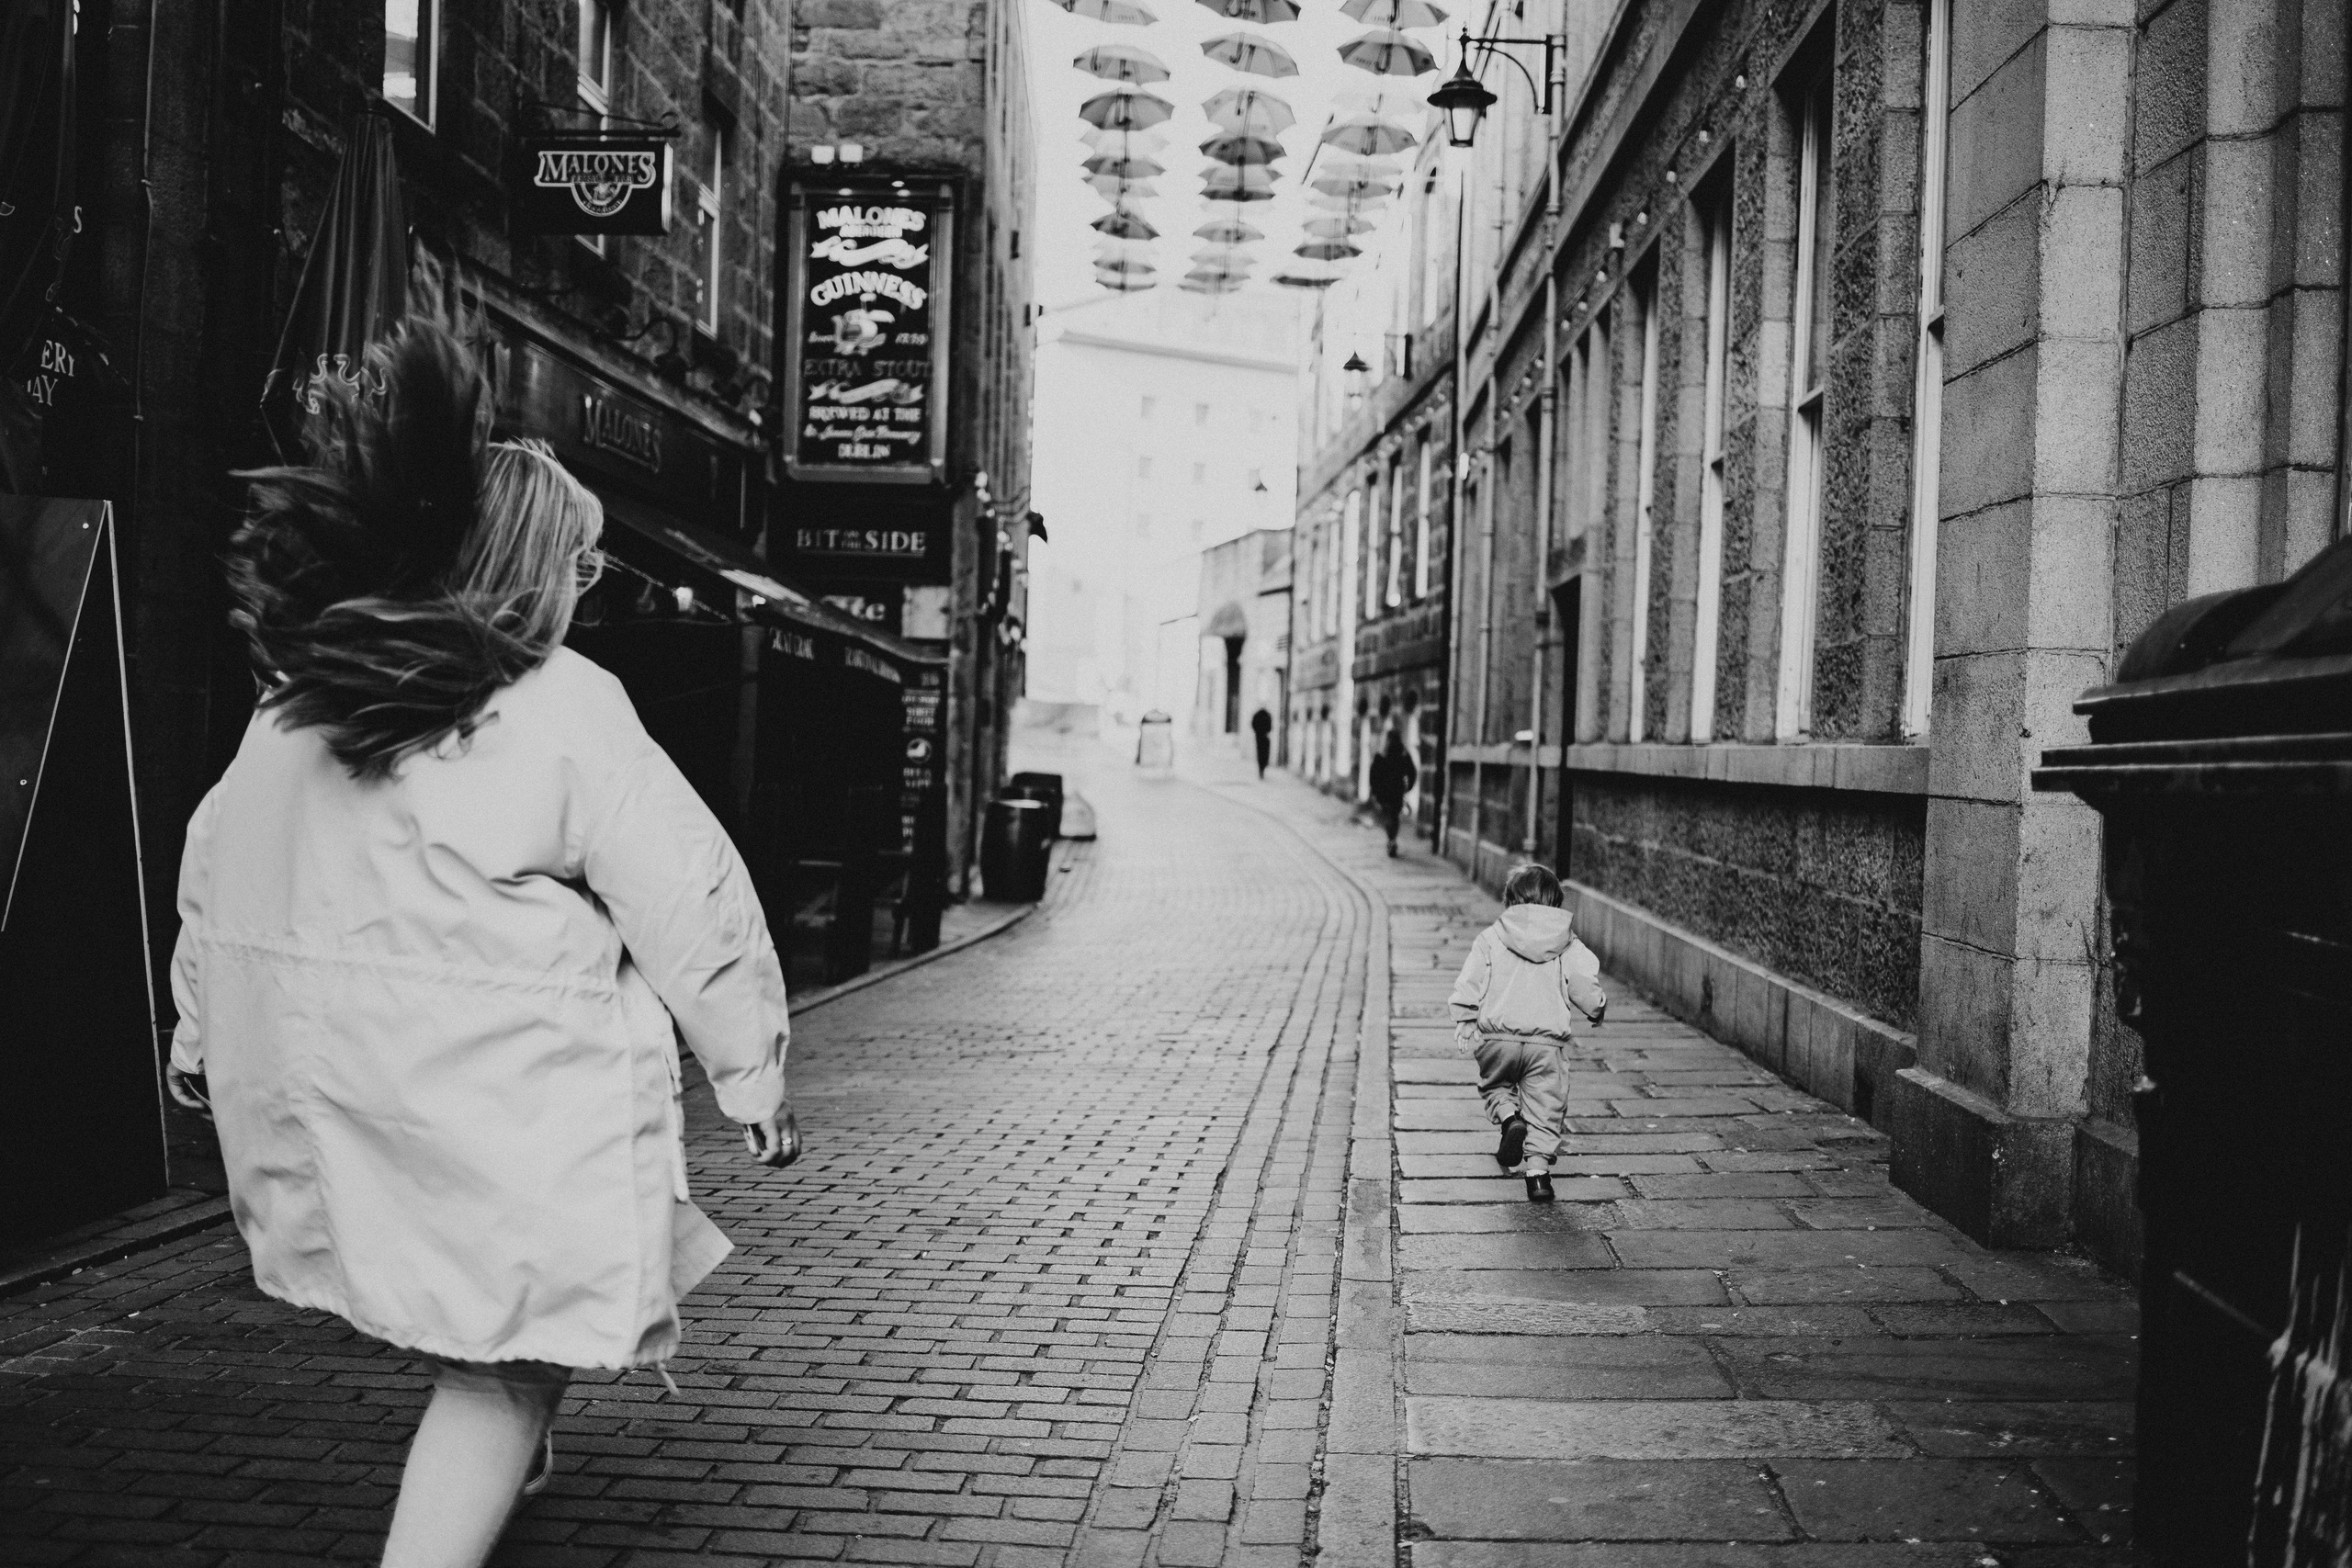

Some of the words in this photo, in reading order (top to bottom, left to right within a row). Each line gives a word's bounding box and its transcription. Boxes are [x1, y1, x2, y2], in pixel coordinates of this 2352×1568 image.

[544, 152, 651, 183] MALONES
[816, 205, 927, 231] MALONES
[810, 270, 928, 310] GUINNESS
[797, 528, 840, 548] BIT
[865, 530, 926, 552] SIDE
